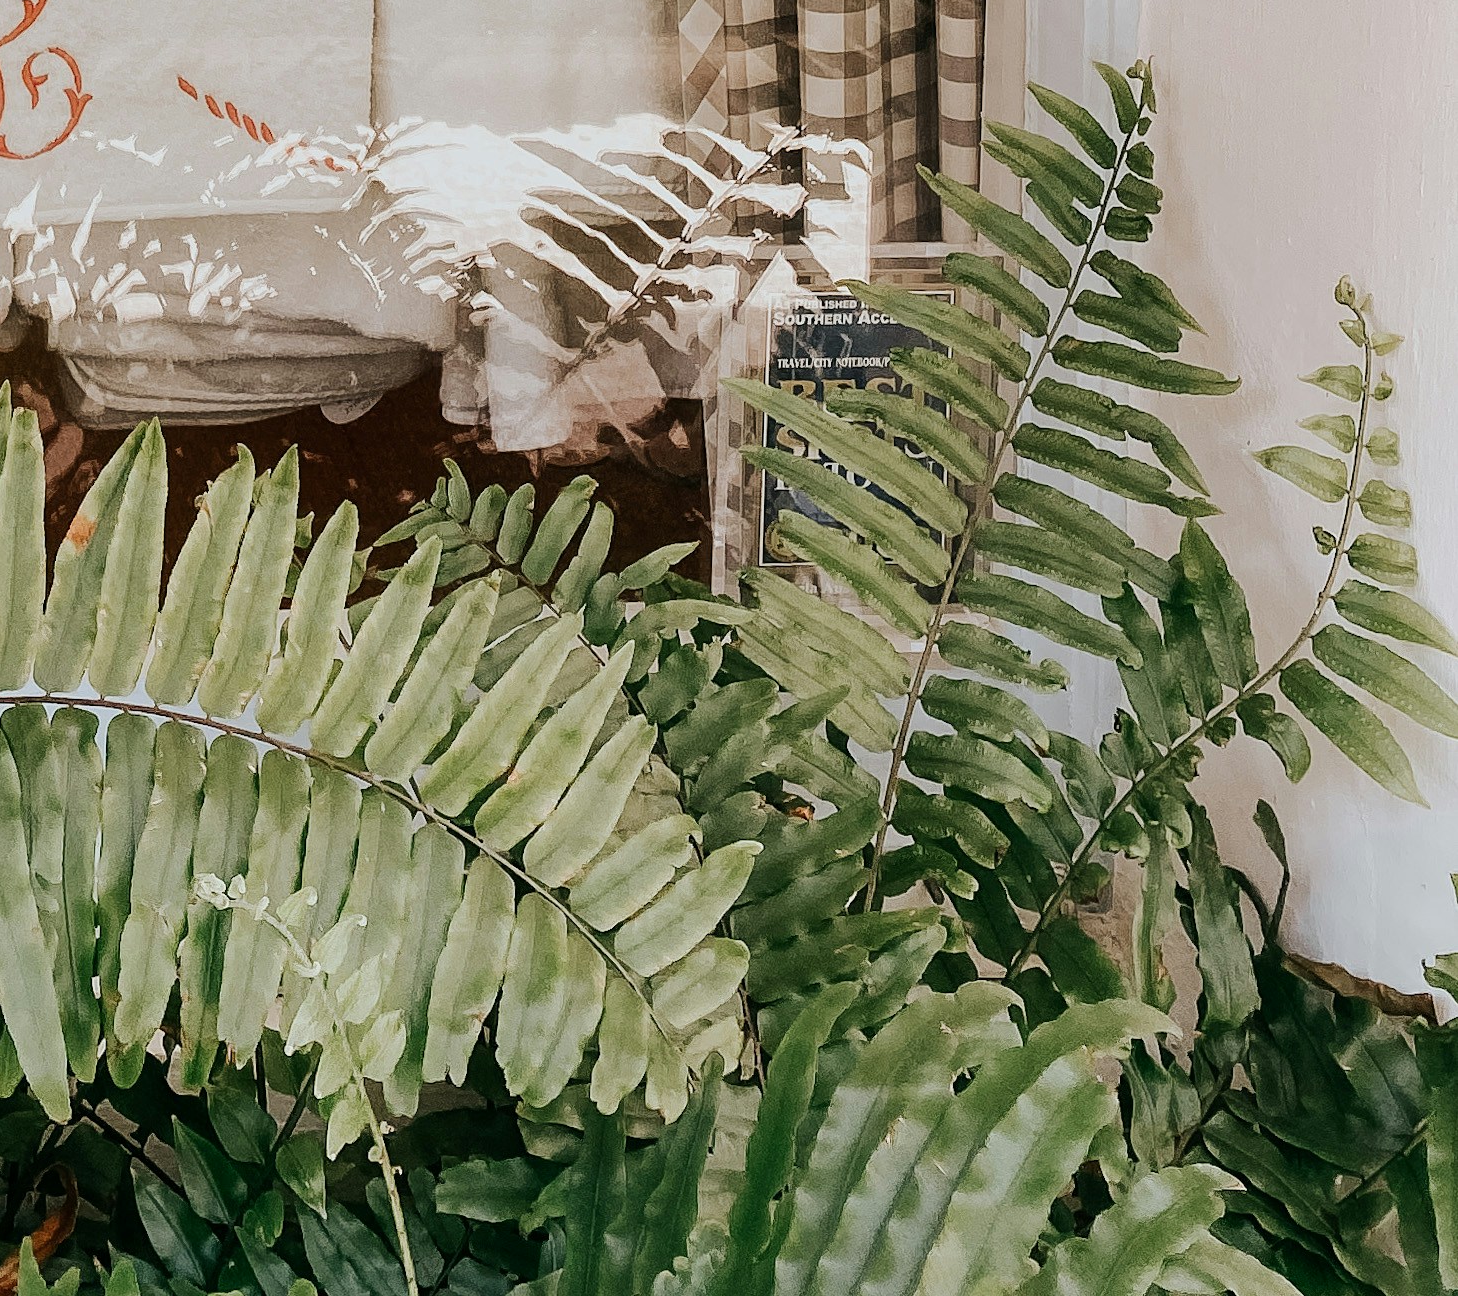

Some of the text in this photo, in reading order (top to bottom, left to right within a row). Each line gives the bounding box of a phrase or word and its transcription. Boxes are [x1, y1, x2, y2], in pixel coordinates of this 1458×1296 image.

[794, 299, 858, 310] PUBLISHED
[773, 311, 854, 326] SOUTHERN
[777, 356, 833, 369] TRAVEL/CITY
